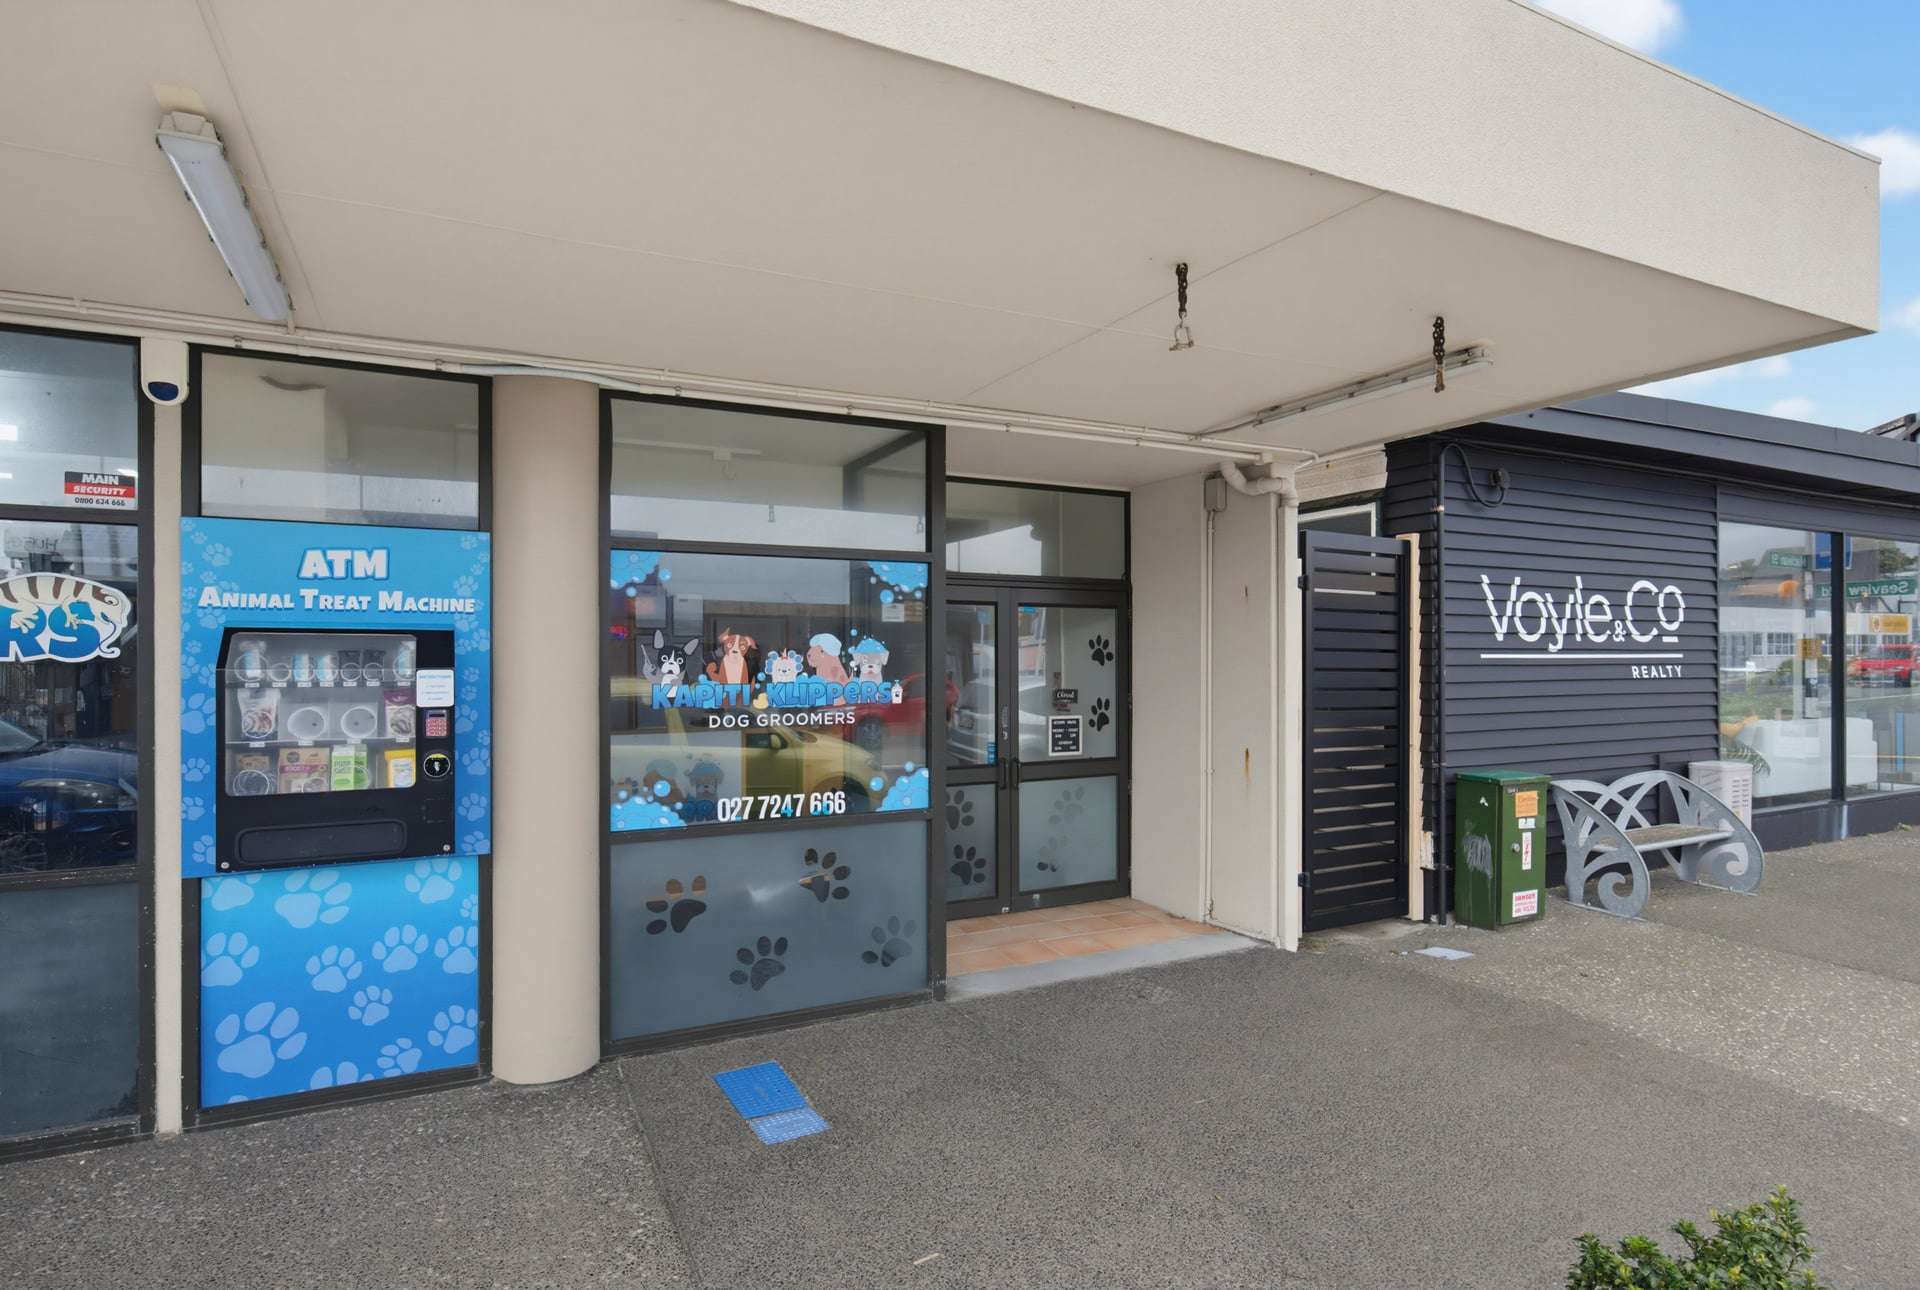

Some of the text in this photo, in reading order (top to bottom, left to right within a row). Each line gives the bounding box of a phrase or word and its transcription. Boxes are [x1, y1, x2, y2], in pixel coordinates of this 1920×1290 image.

[82, 473, 119, 485] MAIN
[73, 485, 127, 496] SECURITY
[296, 548, 389, 580] ATM
[198, 586, 476, 614] ANIMAL TREAT MACHINE
[1631, 665, 1682, 679] REALTY
[652, 683, 751, 709] KAPITI
[708, 711, 856, 729] DOG GROOMERS
[717, 797, 754, 822] 027
[758, 793, 805, 819] 7247
[810, 790, 846, 817] 666
